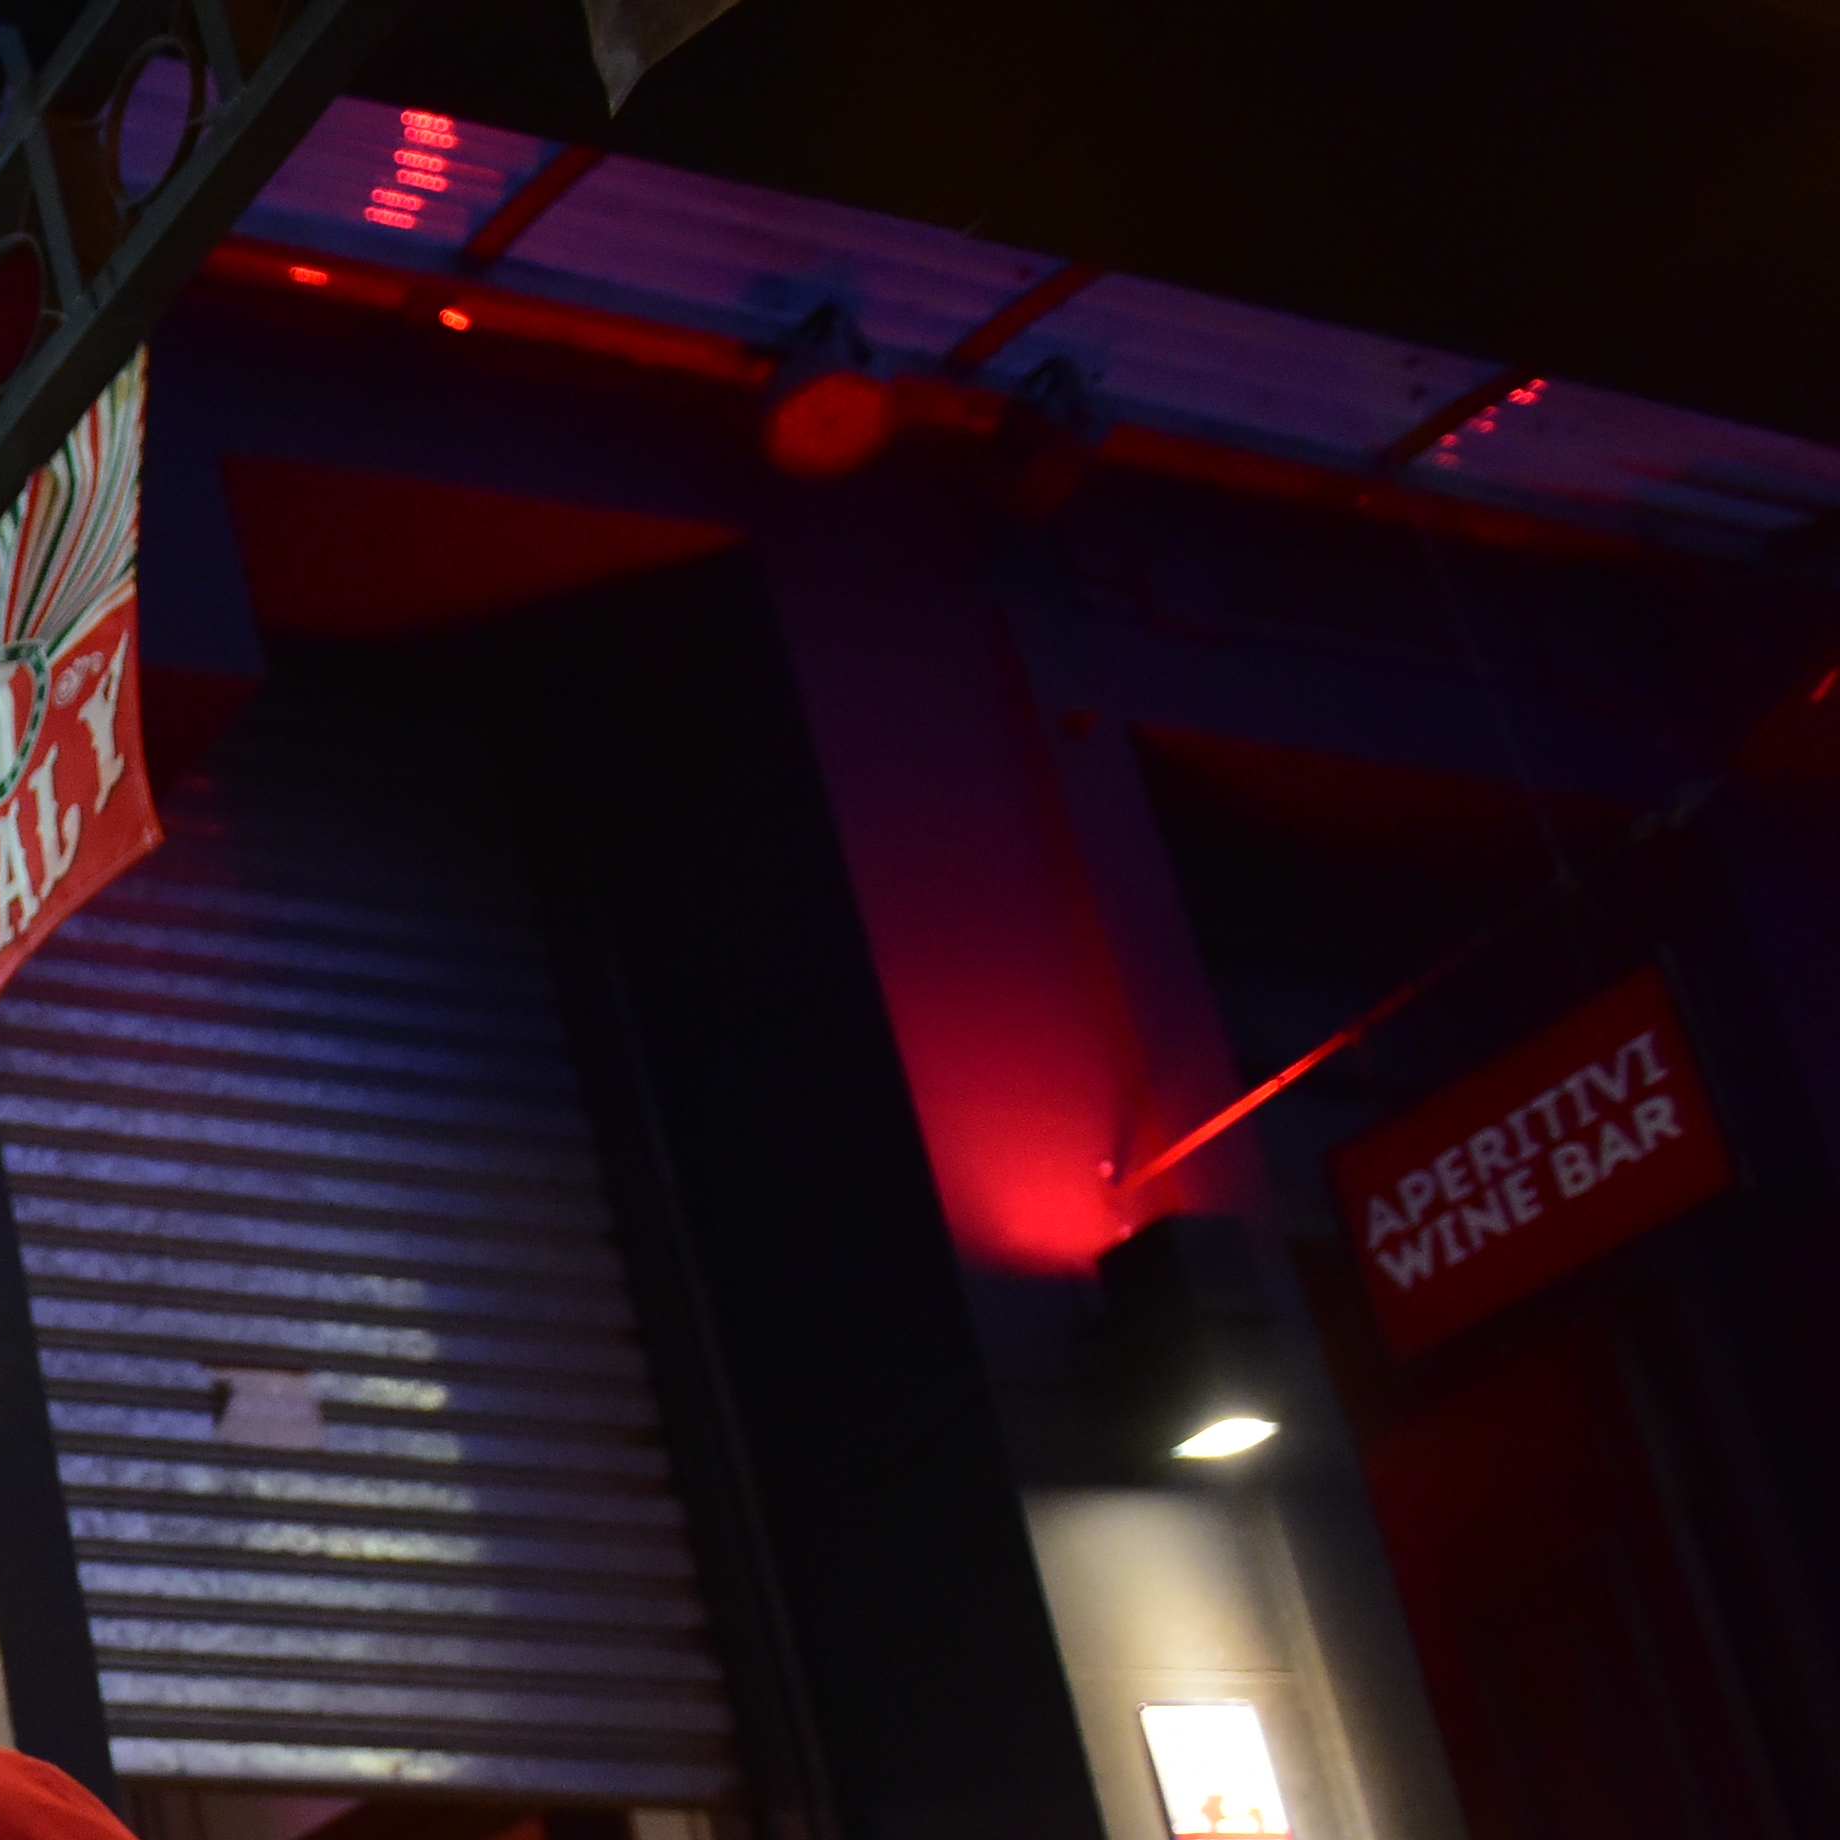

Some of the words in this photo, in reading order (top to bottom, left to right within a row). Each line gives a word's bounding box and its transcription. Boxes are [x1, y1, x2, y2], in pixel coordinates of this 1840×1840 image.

[1366, 1029, 1670, 1251] APERITIVI
[1373, 1166, 1545, 1291] WINE
[1548, 1093, 1686, 1200] BAR
